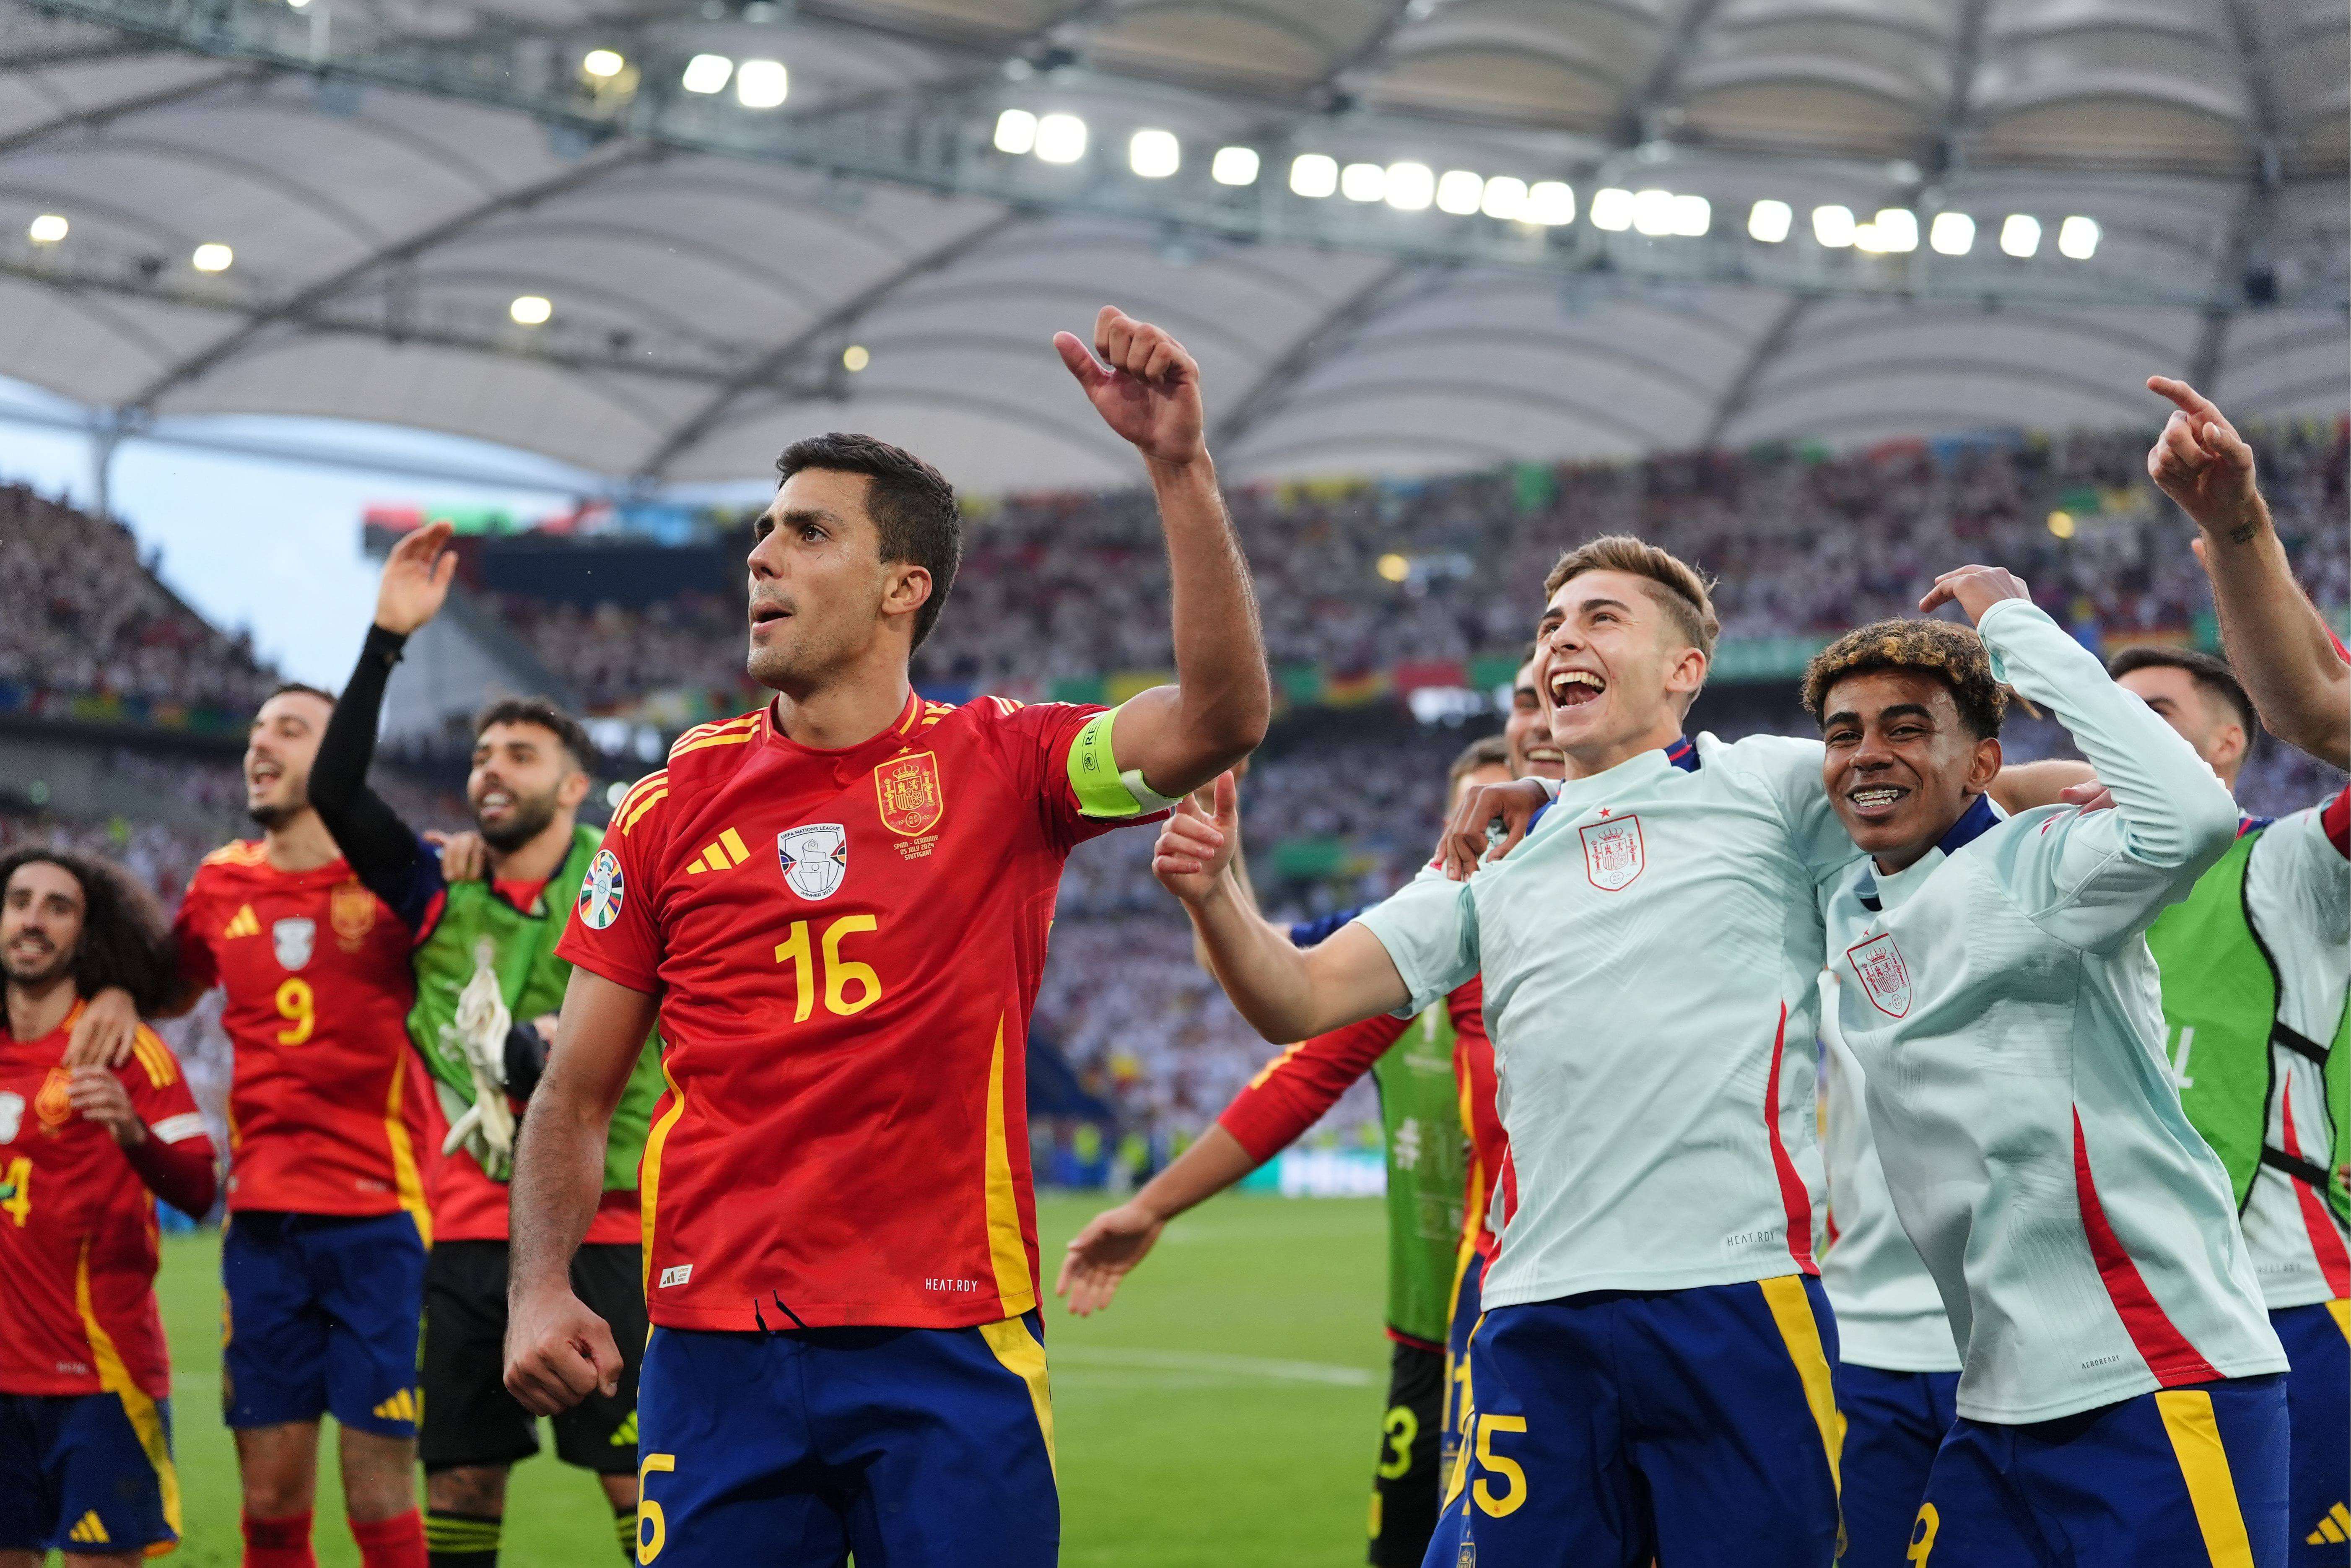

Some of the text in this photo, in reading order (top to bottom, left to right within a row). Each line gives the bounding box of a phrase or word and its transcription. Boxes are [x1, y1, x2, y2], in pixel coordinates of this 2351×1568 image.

[893, 841, 909, 850] SPAIN
[913, 835, 939, 845] GERMANY
[904, 849, 932, 861] STUTTGART
[823, 887, 834, 896] 2023
[775, 914, 882, 1024] 16
[275, 977, 314, 1046] 9
[0, 1157, 32, 1227] 4
[1727, 1231, 1774, 1246] HEAT.RDY
[926, 1278, 978, 1292] HEAT.RDY
[2082, 1354, 2120, 1369] AEROREADY
[1378, 1407, 1418, 1479] 3
[1472, 1413, 1527, 1518] 5
[637, 1453, 675, 1566] 6
